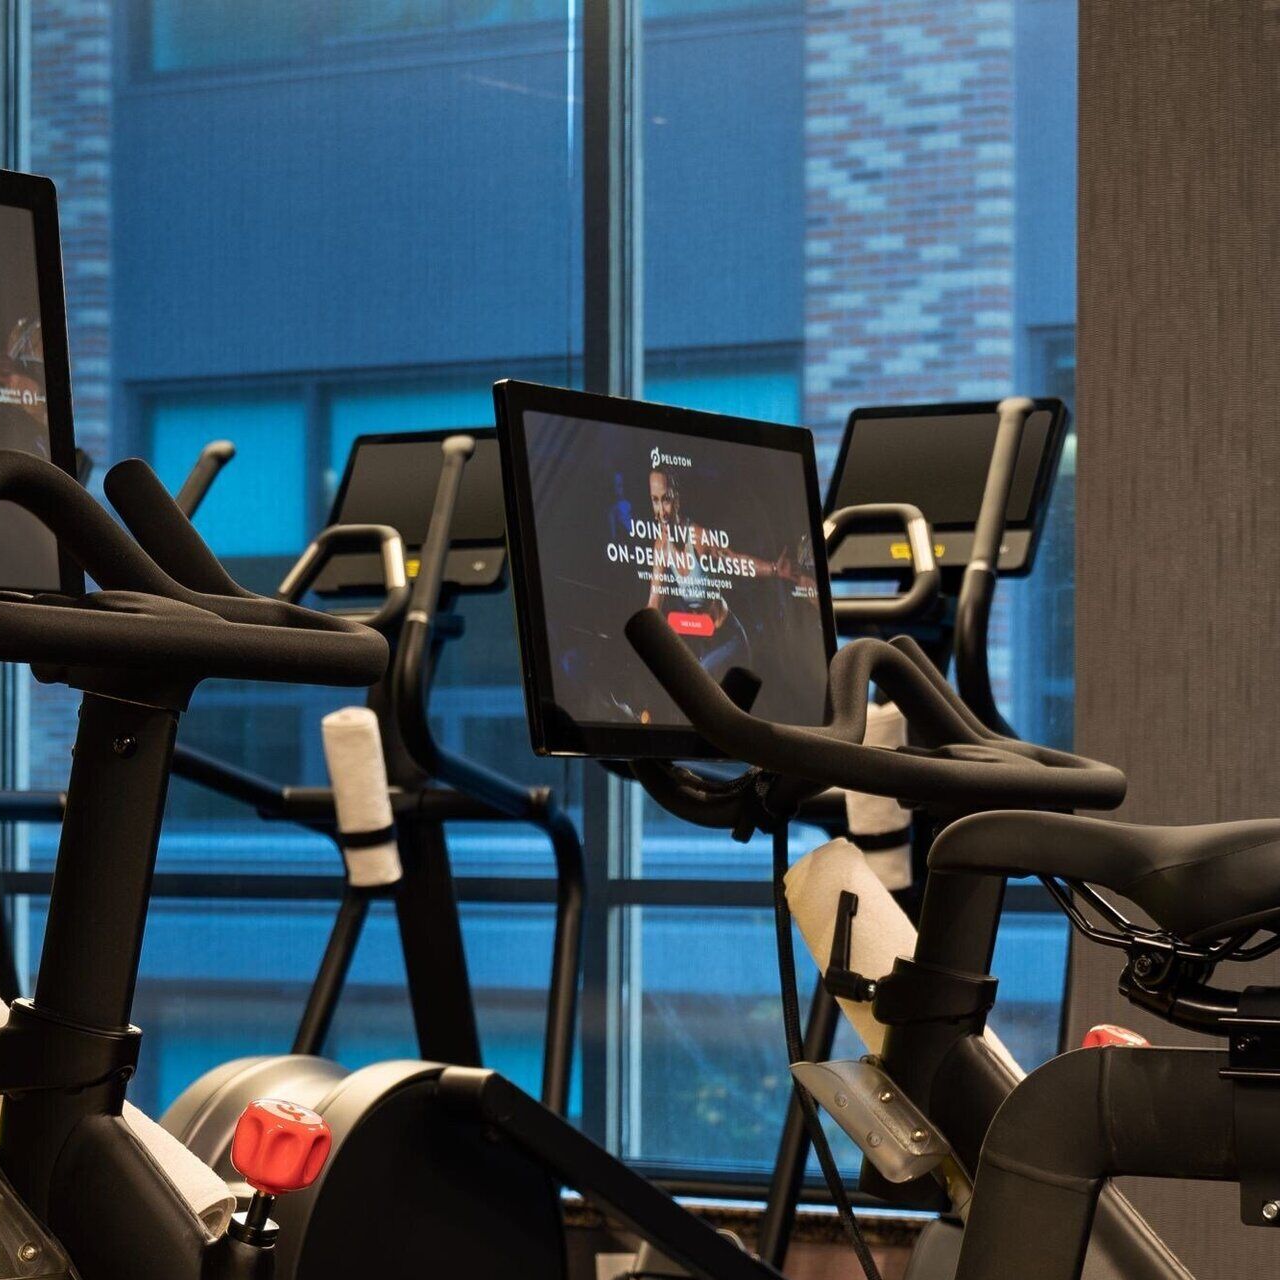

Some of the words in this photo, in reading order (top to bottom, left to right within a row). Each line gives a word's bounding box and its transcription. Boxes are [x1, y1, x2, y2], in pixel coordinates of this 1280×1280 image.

[660, 453, 692, 468] PELOTON
[629, 519, 663, 540] JOIN
[666, 523, 697, 545] LIVE
[700, 529, 729, 549] AND
[606, 543, 695, 570] ON-DEMAND
[699, 554, 756, 578] CLASSES
